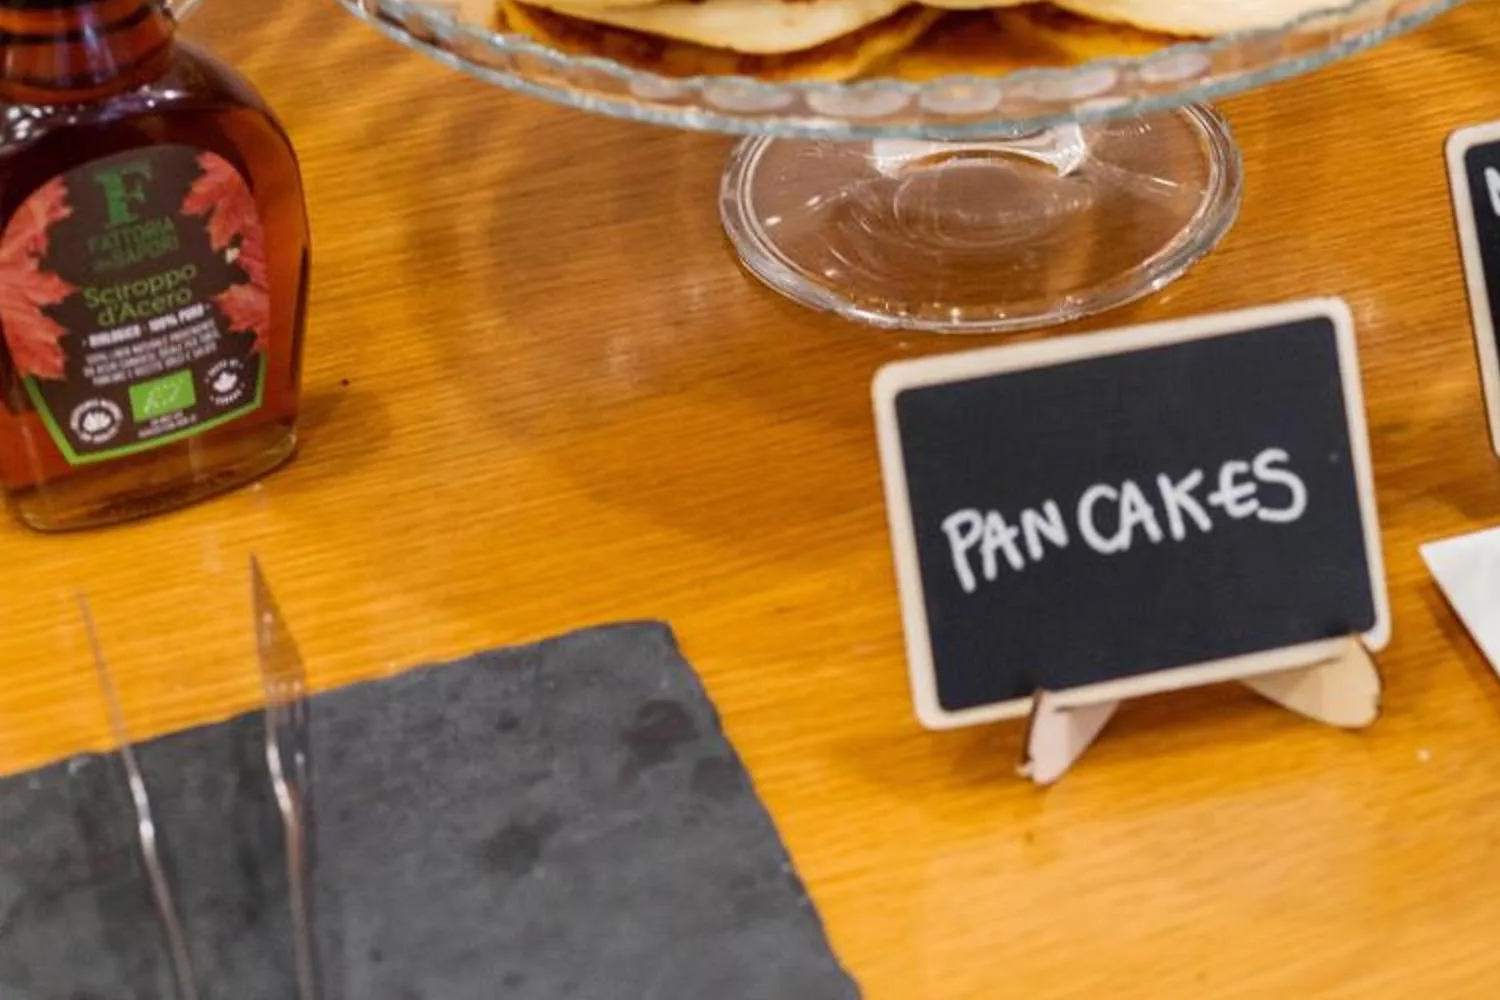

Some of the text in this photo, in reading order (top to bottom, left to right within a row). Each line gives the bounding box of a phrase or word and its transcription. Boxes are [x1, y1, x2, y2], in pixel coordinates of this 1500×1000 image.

[84, 264, 197, 309] Sciroppo
[98, 288, 192, 327] d'Acero
[941, 448, 1307, 594] PANCAKES
